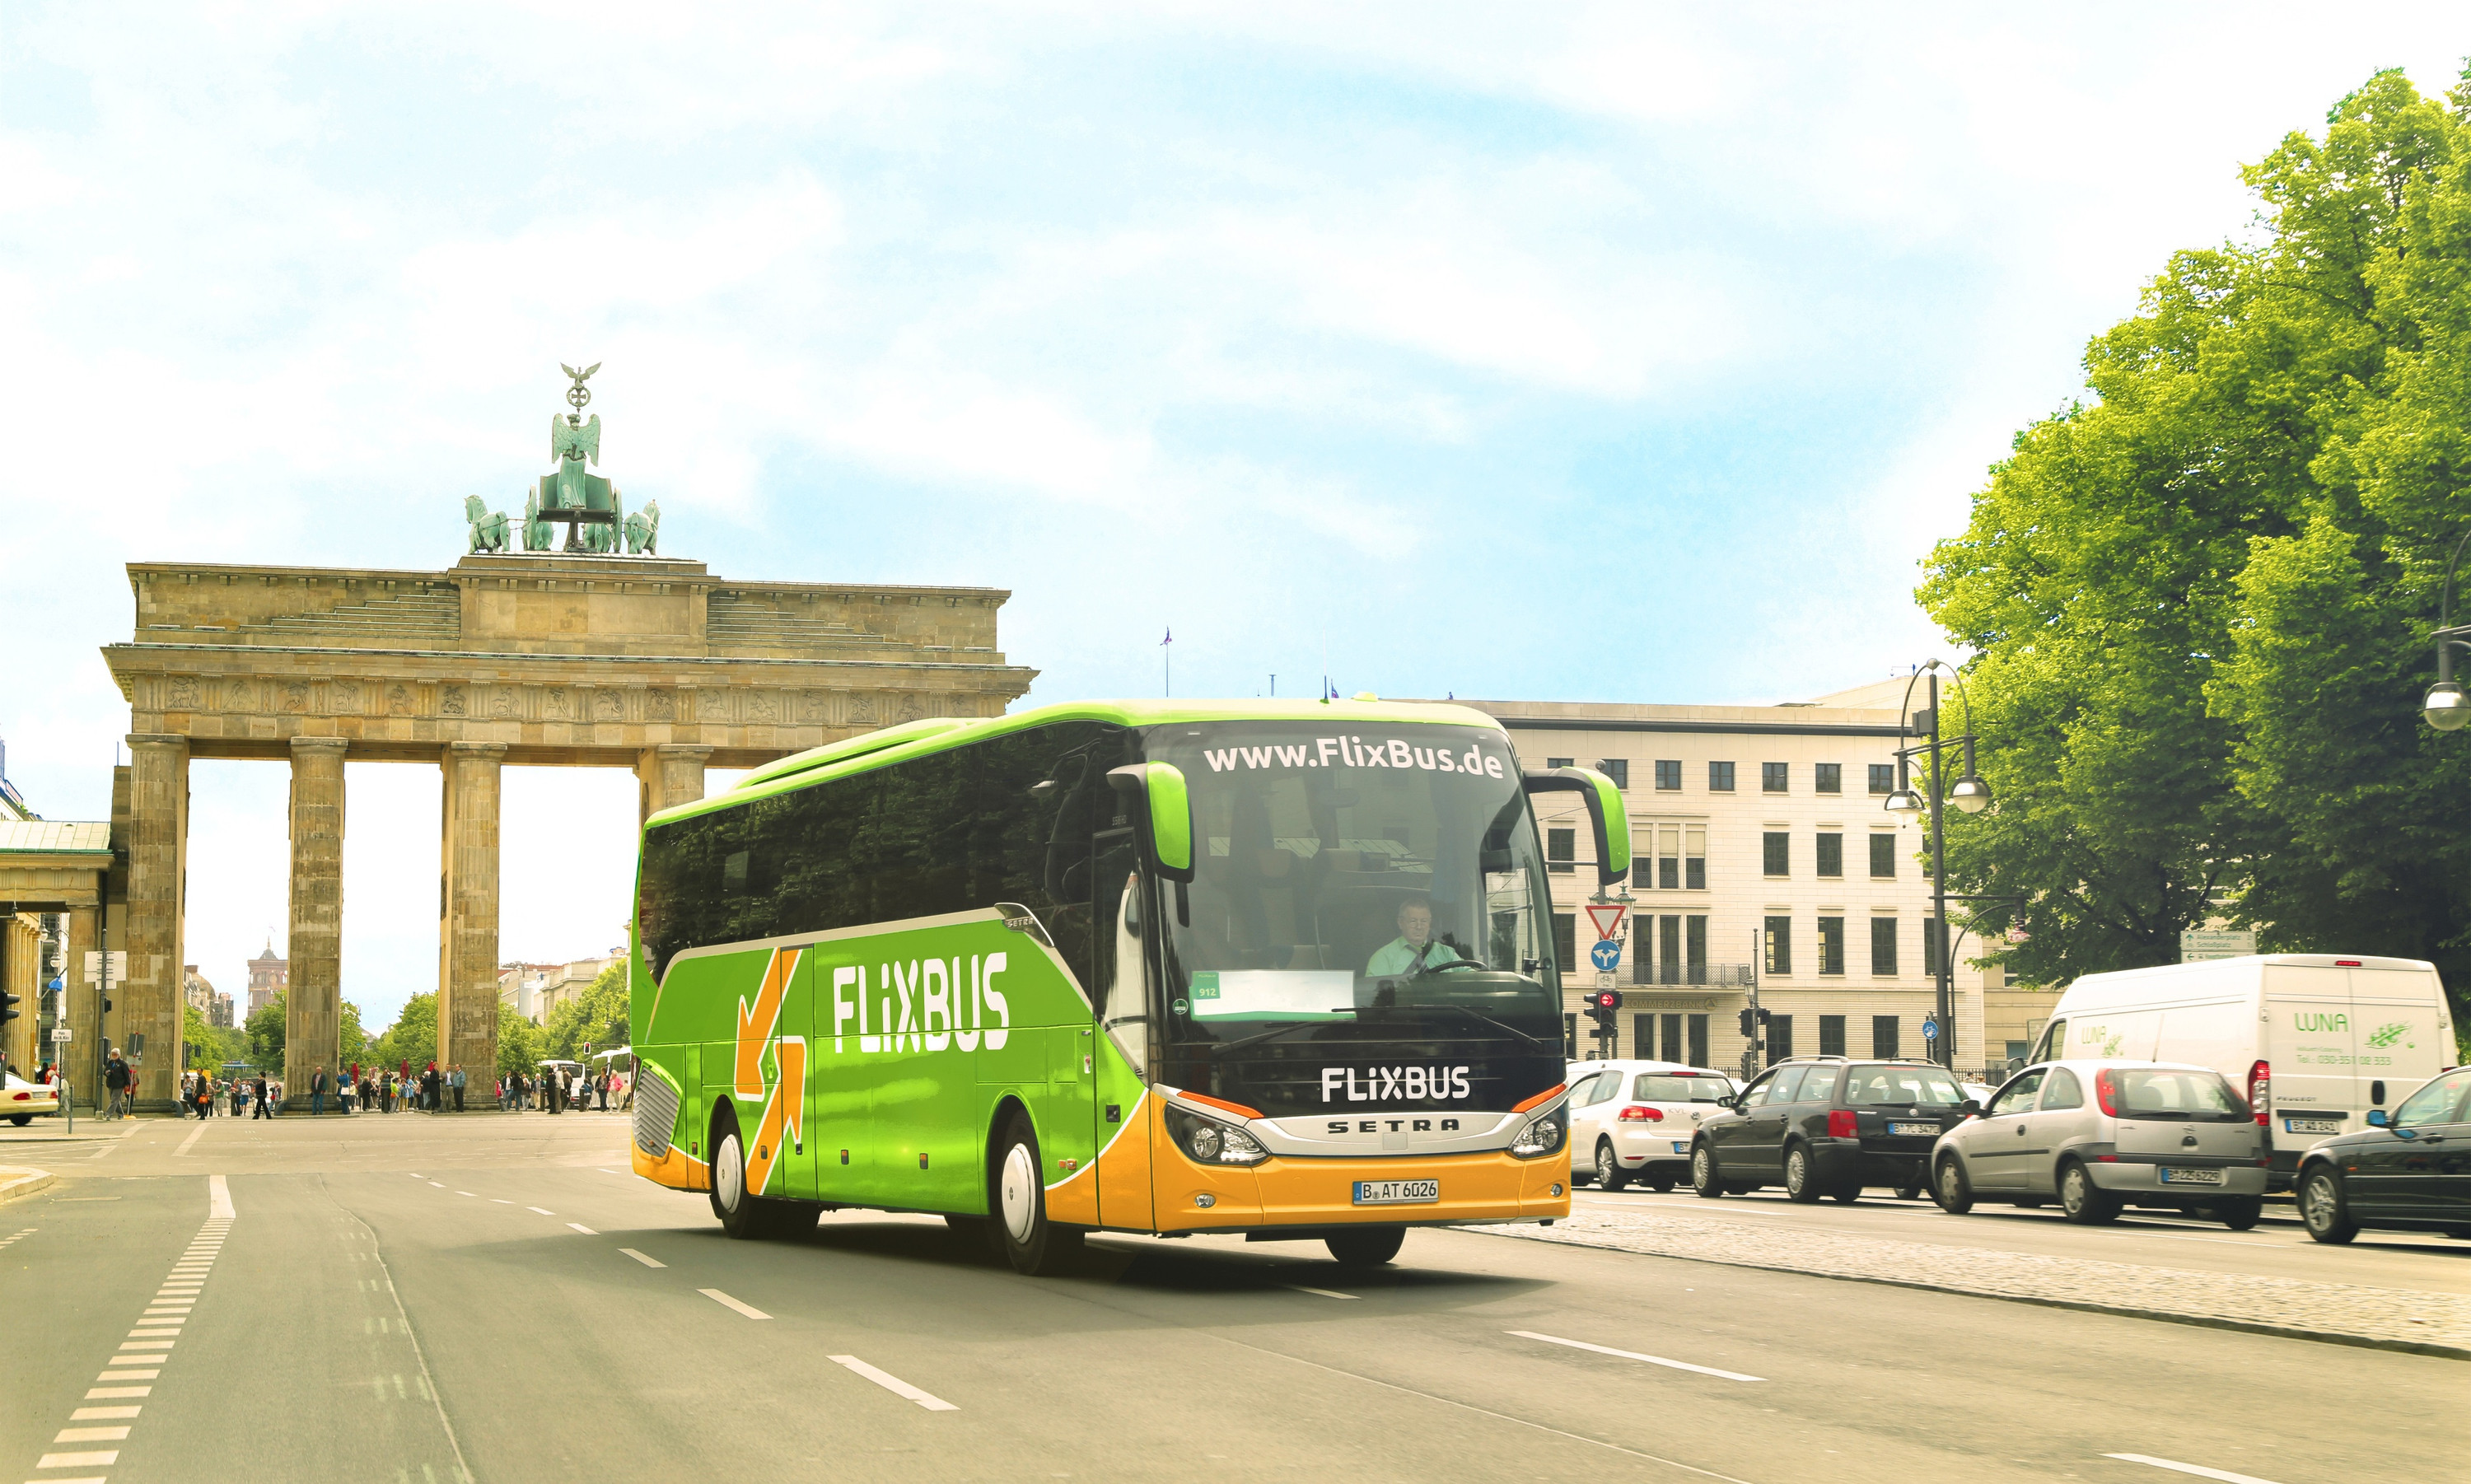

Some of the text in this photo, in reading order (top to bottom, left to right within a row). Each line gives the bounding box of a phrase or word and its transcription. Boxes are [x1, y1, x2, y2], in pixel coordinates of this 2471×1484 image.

[1203, 735, 1504, 779] www.FlixBus.de
[1007, 917, 1034, 928] SETRA
[1198, 987, 1217, 996] 912
[1623, 999, 1702, 1009] COMMERZBANK
[2294, 1012, 2349, 1032] LUNA
[2081, 1025, 2107, 1044] LUNA
[1327, 1118, 1460, 1134] SETRA
[1363, 1182, 1436, 1199] B AT 6026
